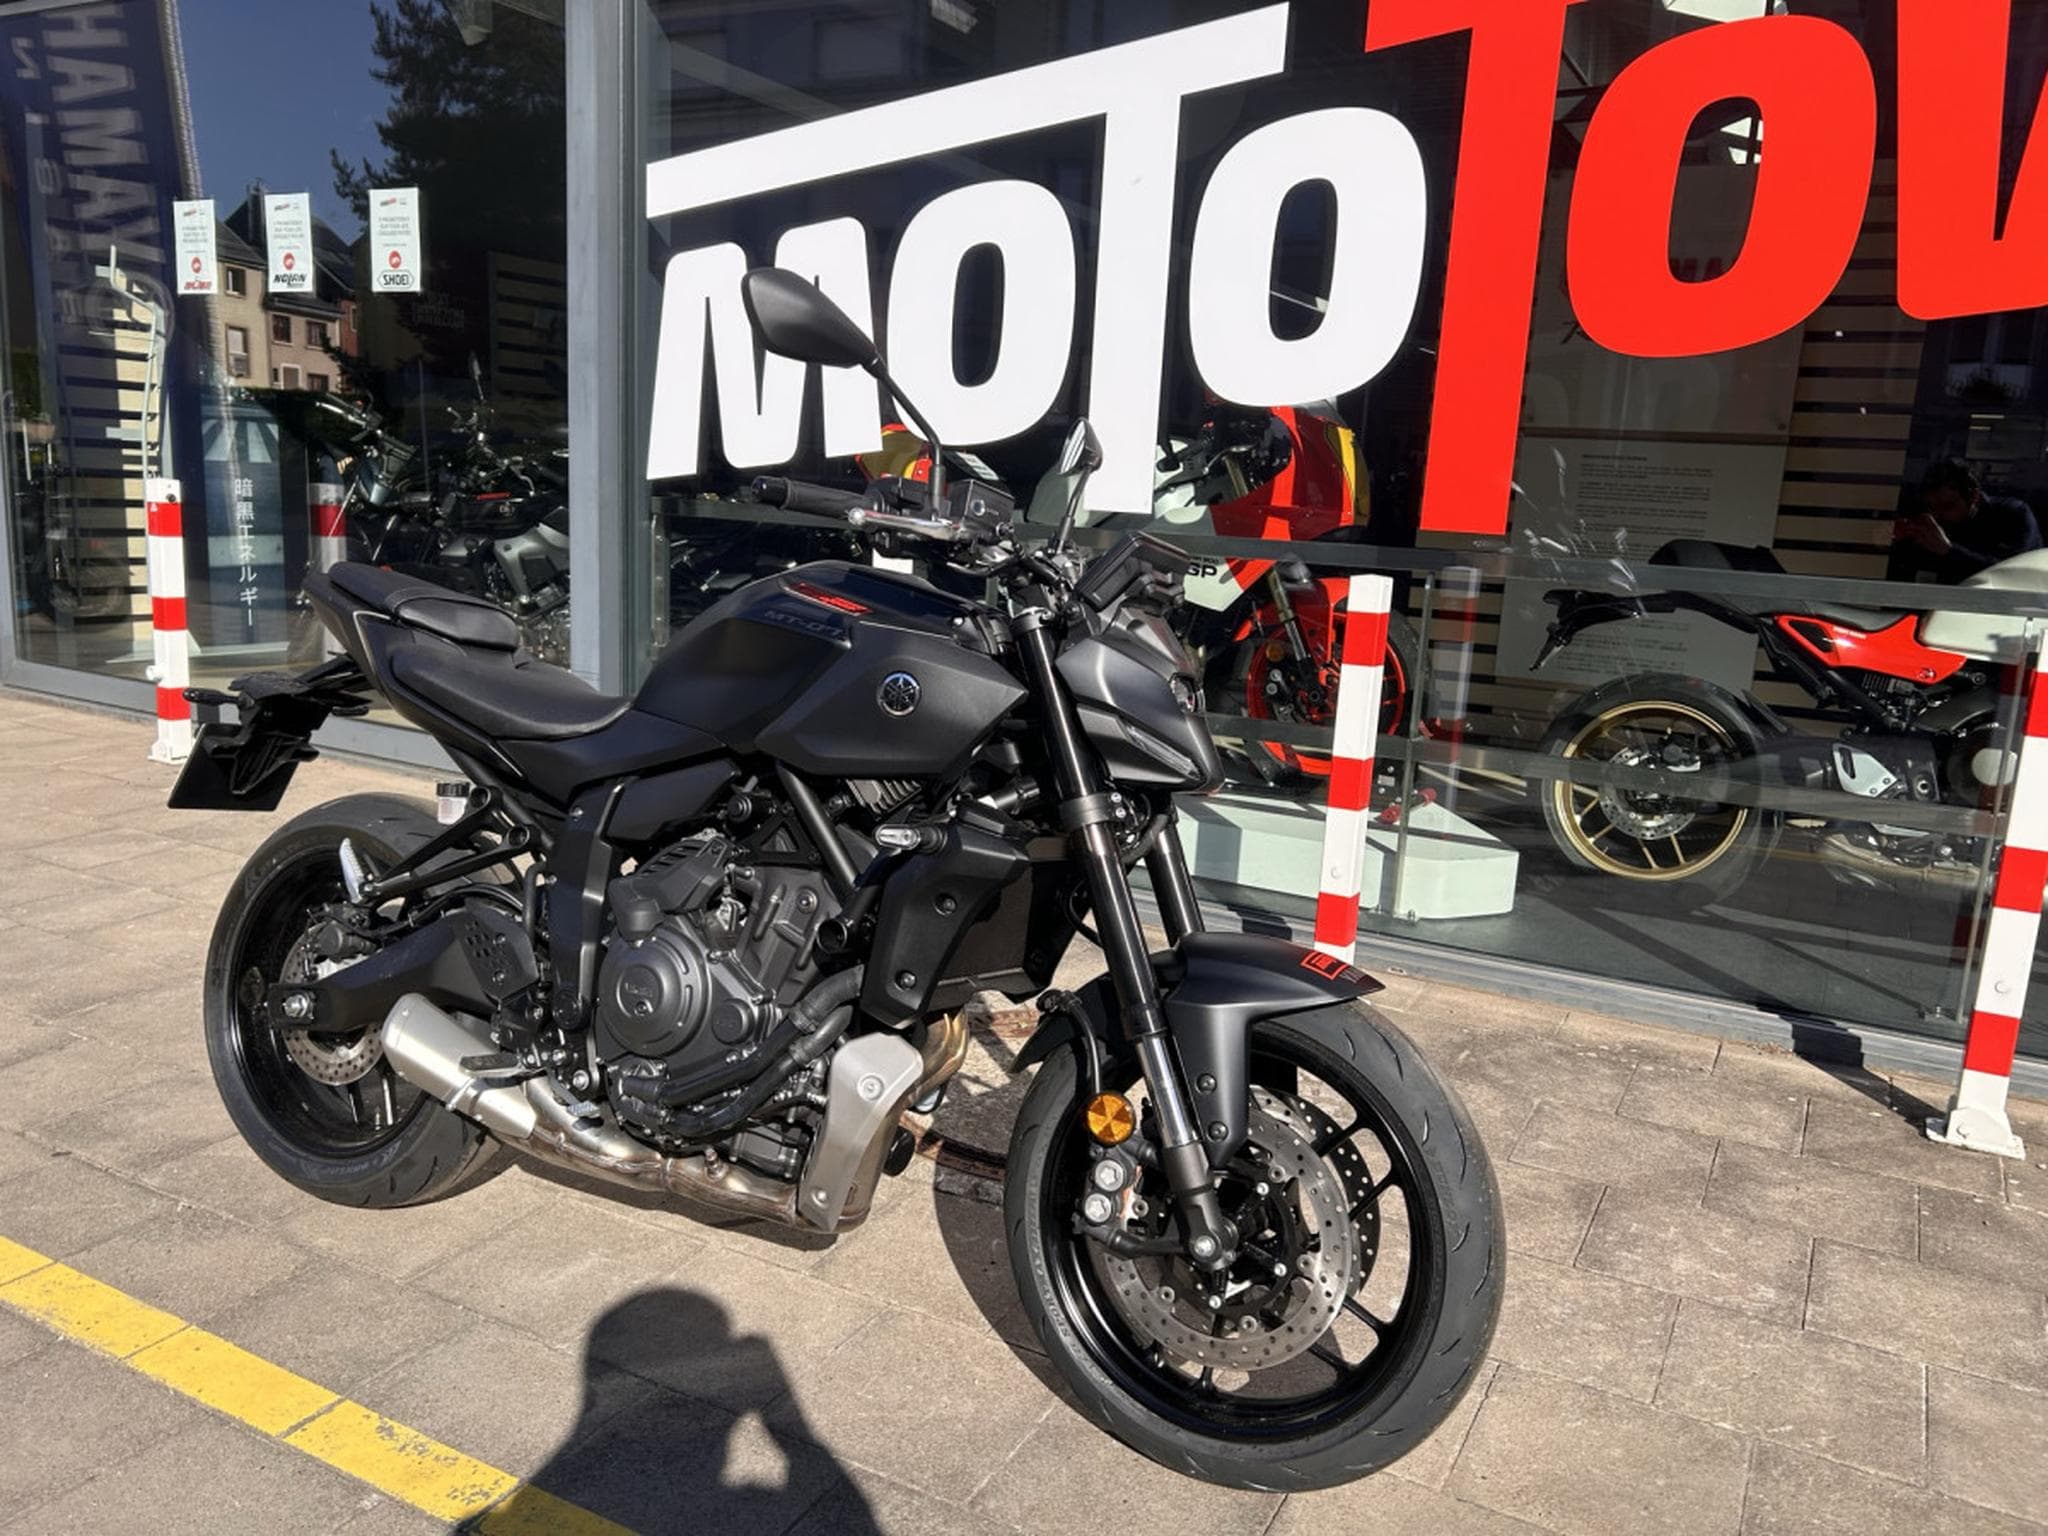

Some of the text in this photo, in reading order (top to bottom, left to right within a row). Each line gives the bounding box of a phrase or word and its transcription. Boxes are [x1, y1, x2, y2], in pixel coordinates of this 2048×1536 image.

[383, 273, 409, 286] SHOEI
[234, 478, 258, 627] 暗黒エネルギー
